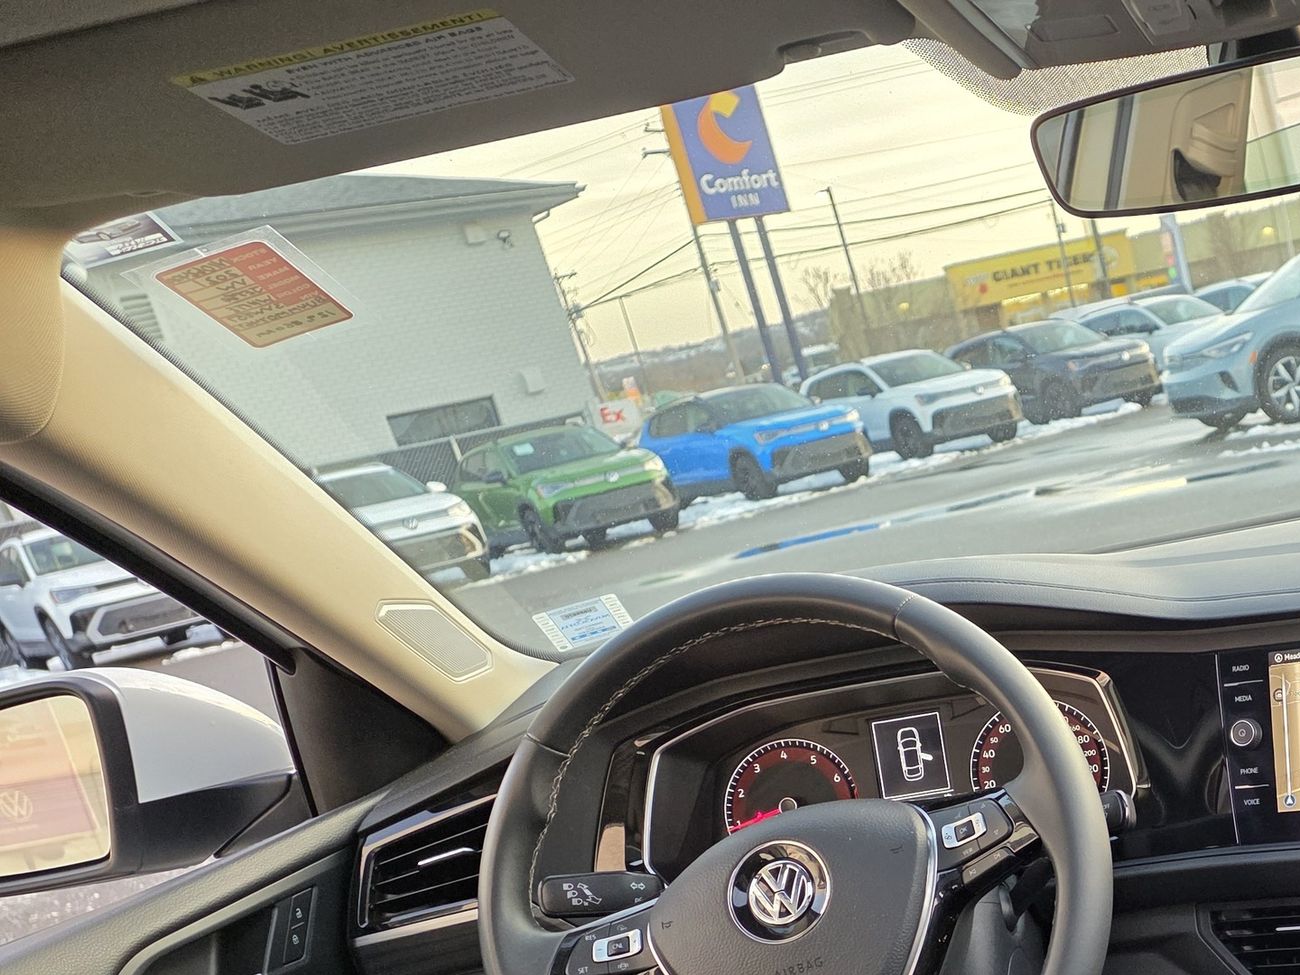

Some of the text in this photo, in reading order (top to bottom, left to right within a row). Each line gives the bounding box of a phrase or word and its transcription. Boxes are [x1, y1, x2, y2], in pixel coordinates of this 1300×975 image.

[214, 50, 313, 78] WARNING!
[322, 11, 483, 55] AVERTISSEMENT!
[700, 168, 779, 195] Comfort
[730, 192, 760, 209] INN
[993, 263, 1041, 282] GIANT
[1232, 664, 1250, 673] RADIO
[1234, 695, 1252, 703] MEDIA
[998, 724, 1011, 733] 60
[780, 750, 788, 760] 4
[982, 749, 995, 759] 40
[810, 755, 817, 765] 5
[753, 763, 760, 773] 3
[1240, 767, 1259, 775] PHONE
[833, 773, 841, 782] 6
[983, 780, 996, 789] 20
[737, 788, 745, 798] 2
[1243, 798, 1260, 806] VOICE
[584, 934, 597, 942] RES
[577, 966, 589, 975] SET
